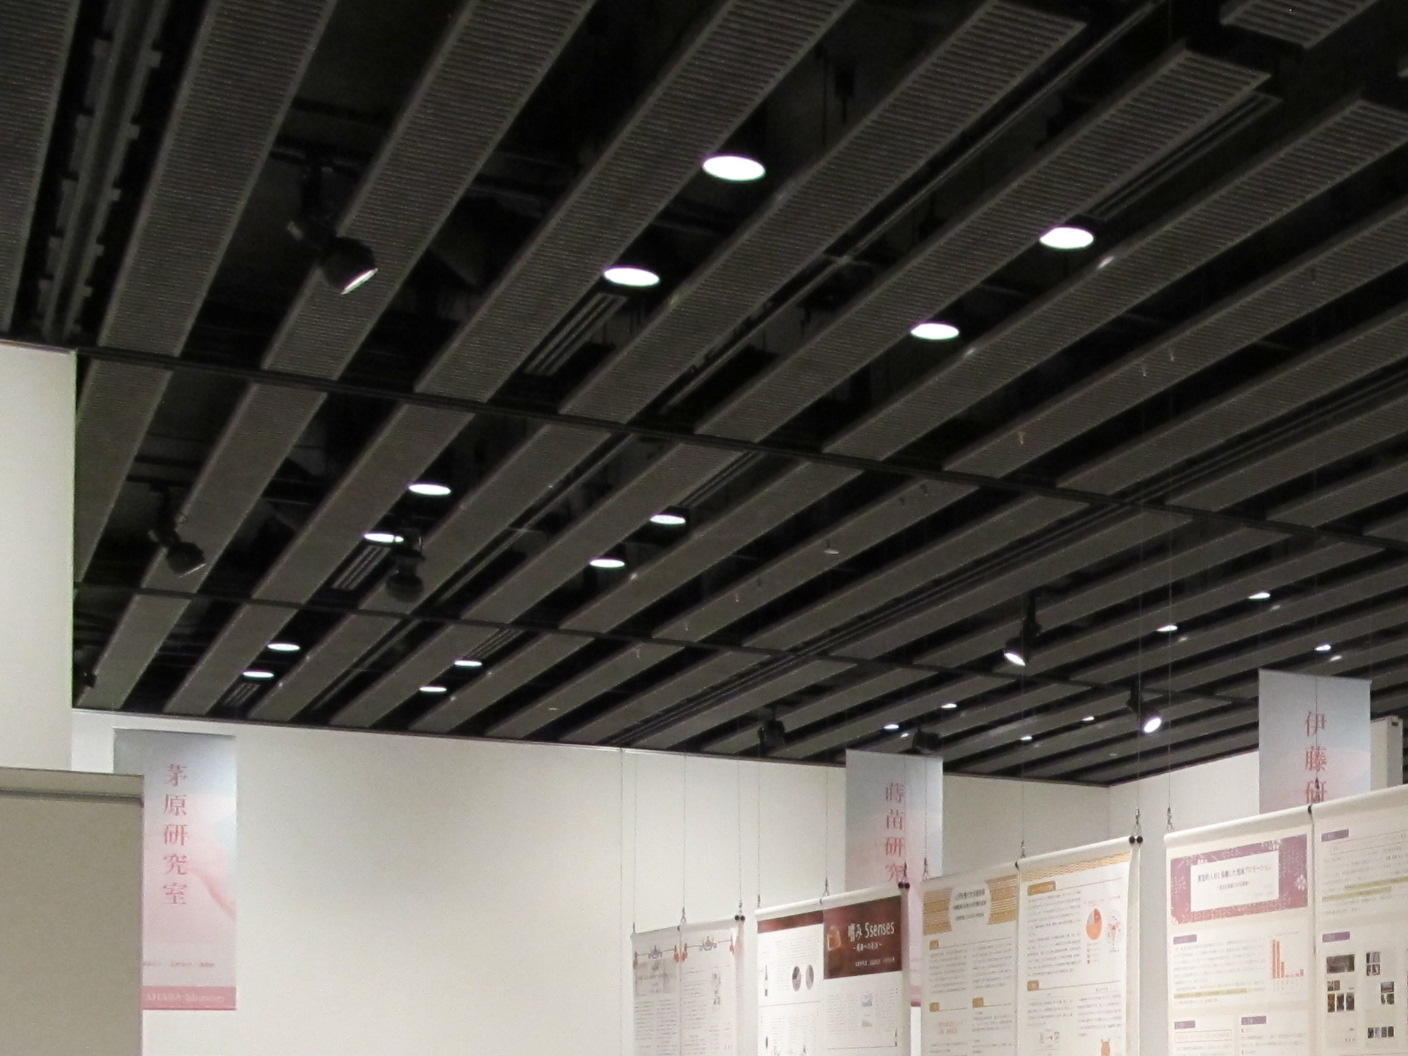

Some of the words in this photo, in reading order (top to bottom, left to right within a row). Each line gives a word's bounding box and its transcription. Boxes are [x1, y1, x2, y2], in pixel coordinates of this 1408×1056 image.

[163, 763, 188, 905] 茅原研究室
